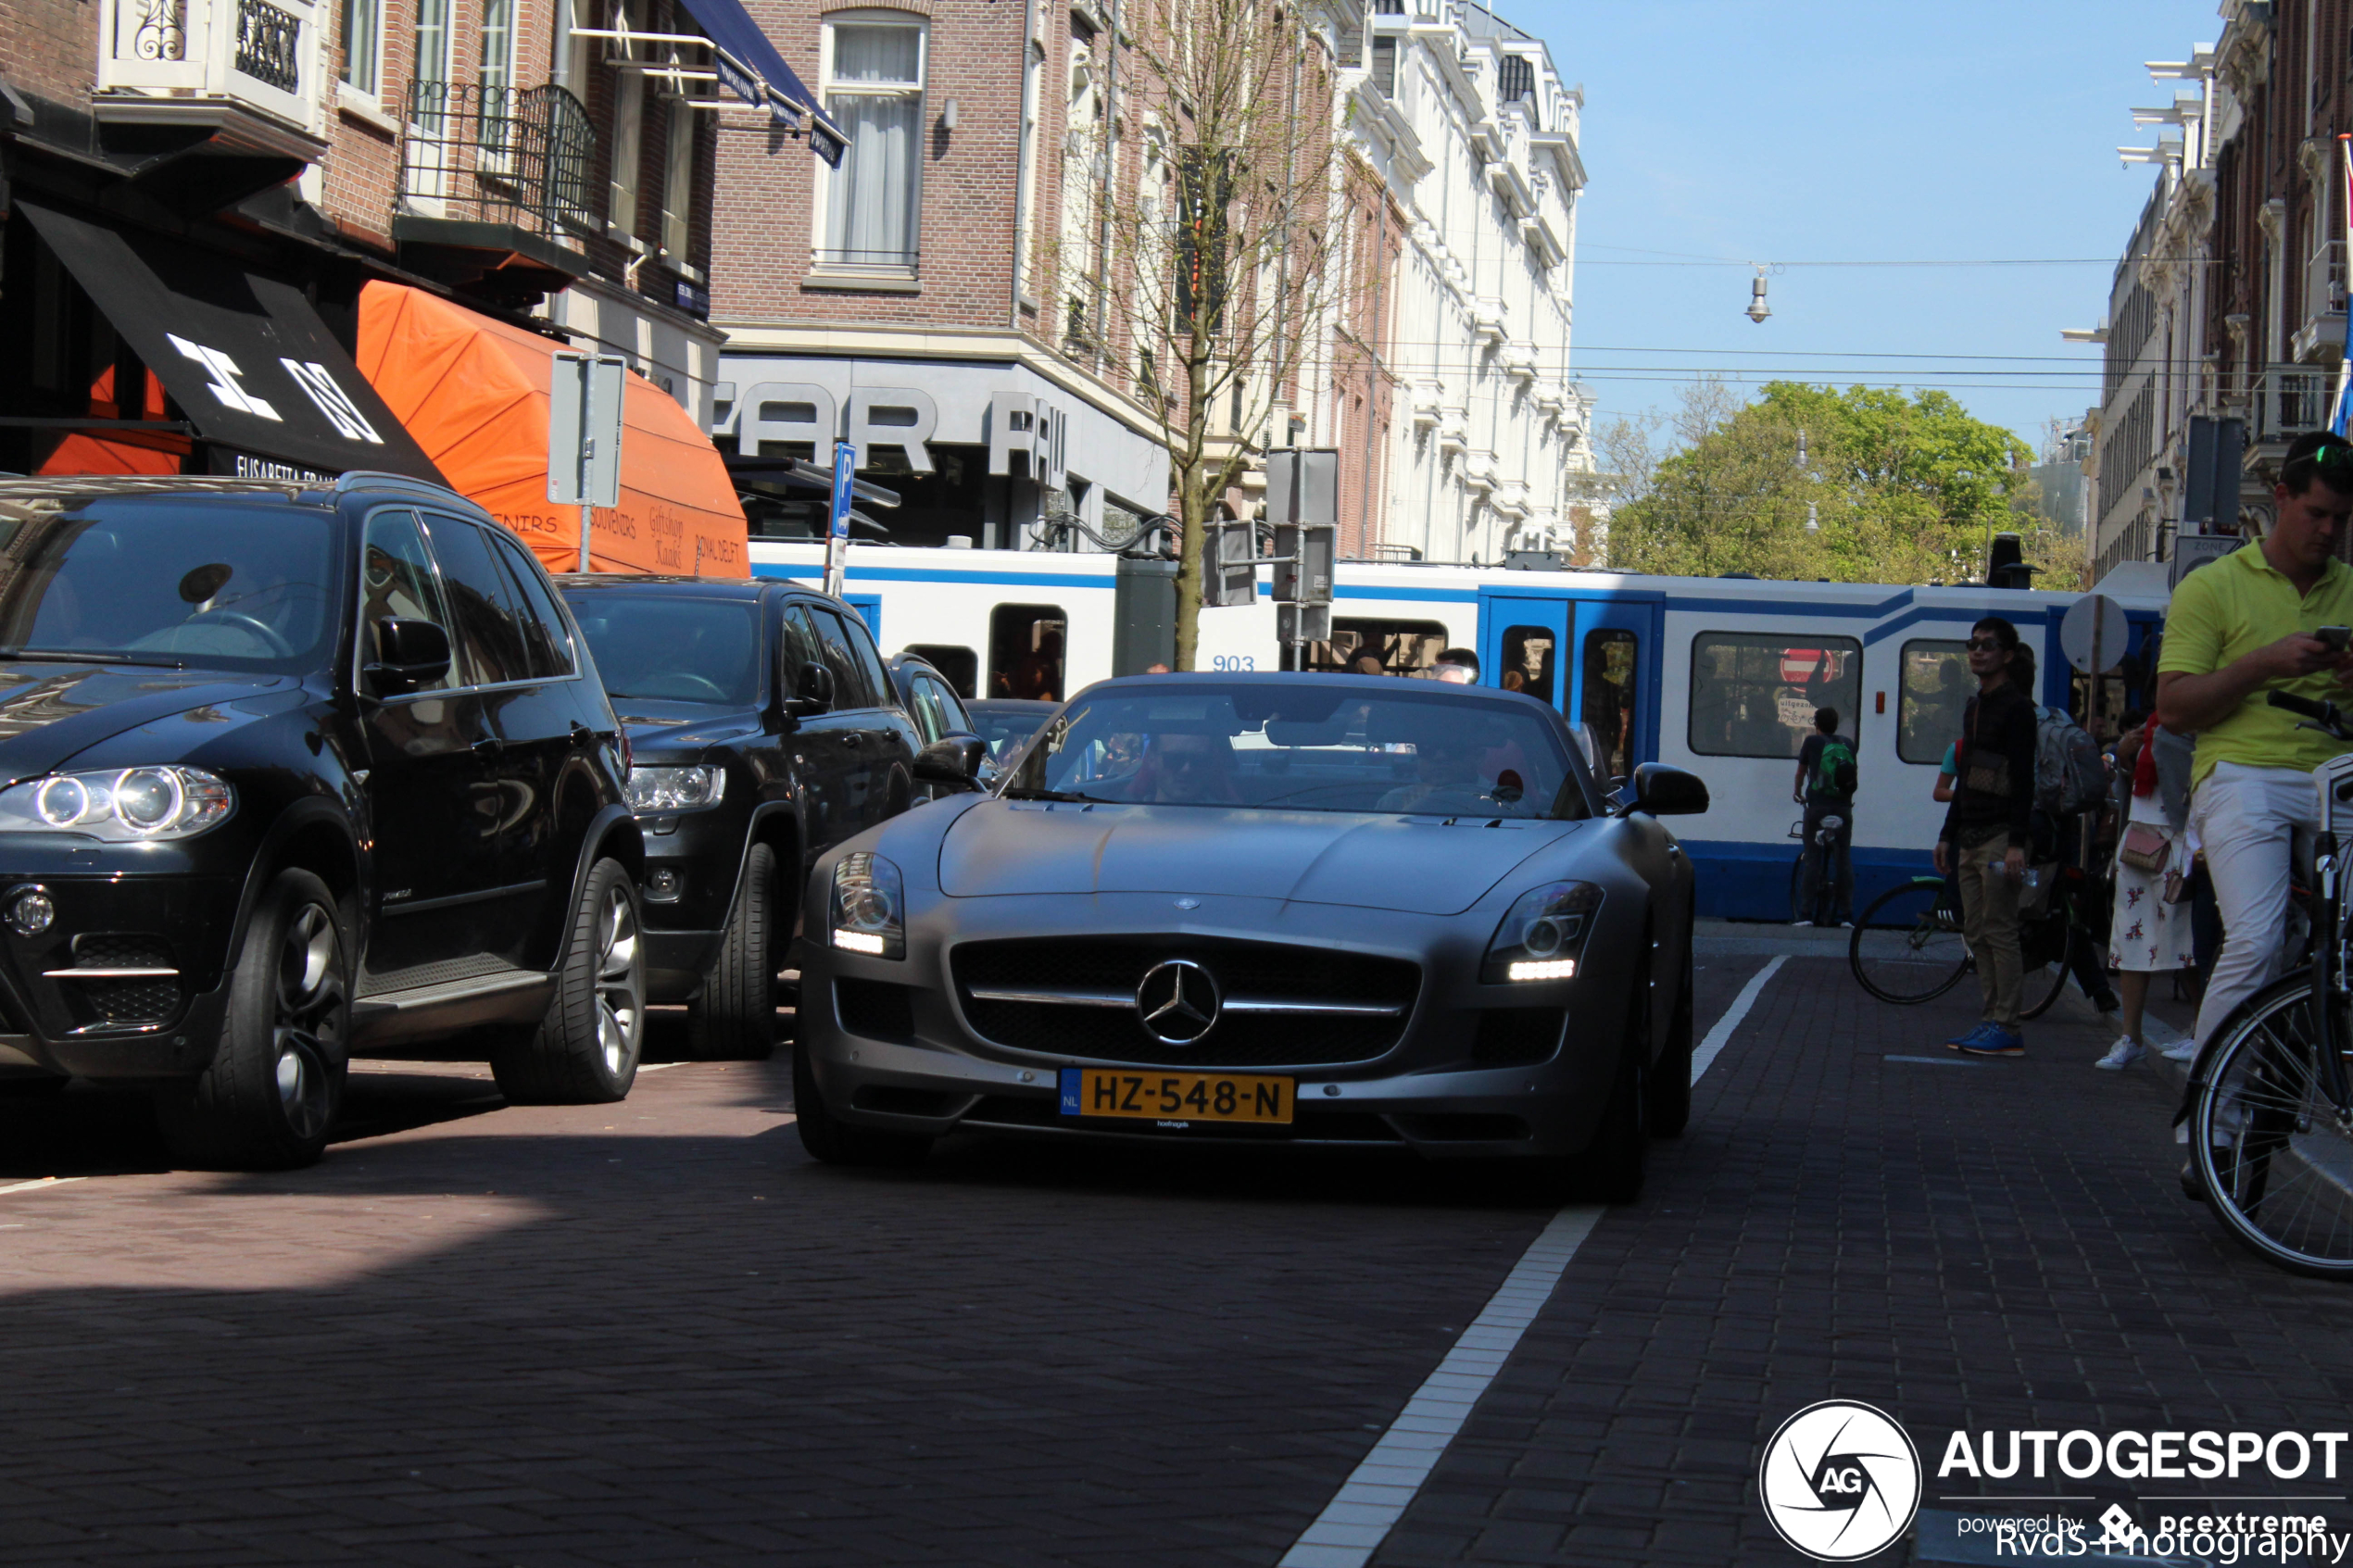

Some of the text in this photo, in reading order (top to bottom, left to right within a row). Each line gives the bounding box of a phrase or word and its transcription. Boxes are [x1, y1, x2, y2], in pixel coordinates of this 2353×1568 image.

[840, 453, 852, 498] P
[492, 513, 558, 533] NIRS
[648, 505, 684, 548] Giftshop
[2194, 541, 2225, 551] ZONE
[1213, 655, 1254, 672] 903
[1063, 1096, 1078, 1108] NL
[1094, 1075, 1280, 1117] HZ-548-N
